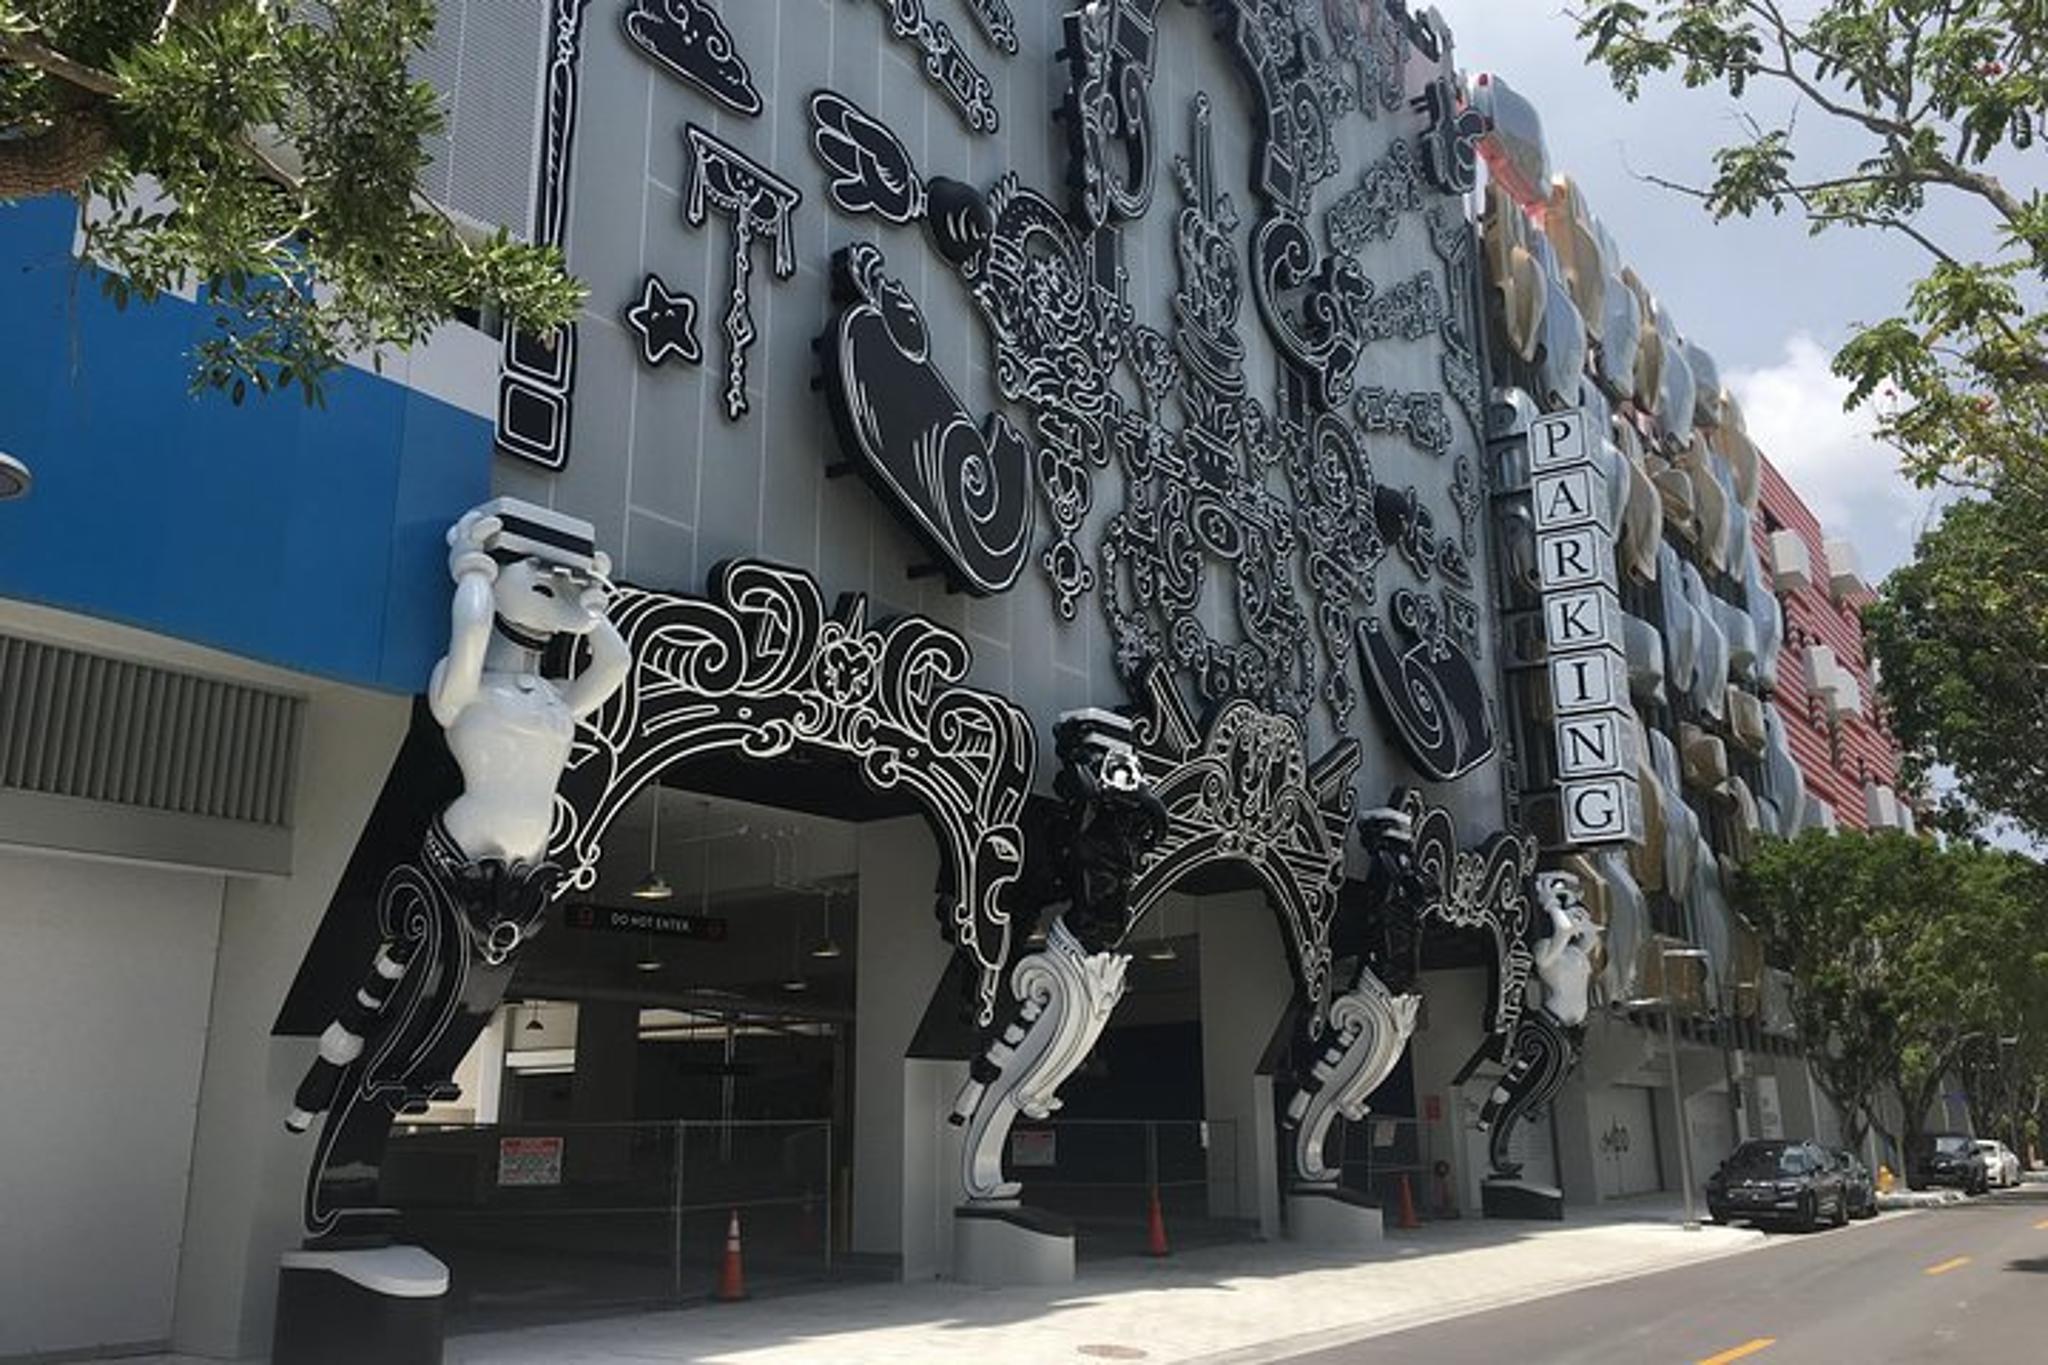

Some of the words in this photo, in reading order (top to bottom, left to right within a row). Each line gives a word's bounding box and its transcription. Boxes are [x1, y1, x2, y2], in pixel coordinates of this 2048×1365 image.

[1544, 420, 1615, 829] PARKING
[610, 911, 629, 926] DO
[631, 914, 653, 928] NOT
[656, 917, 690, 931] ENTER
